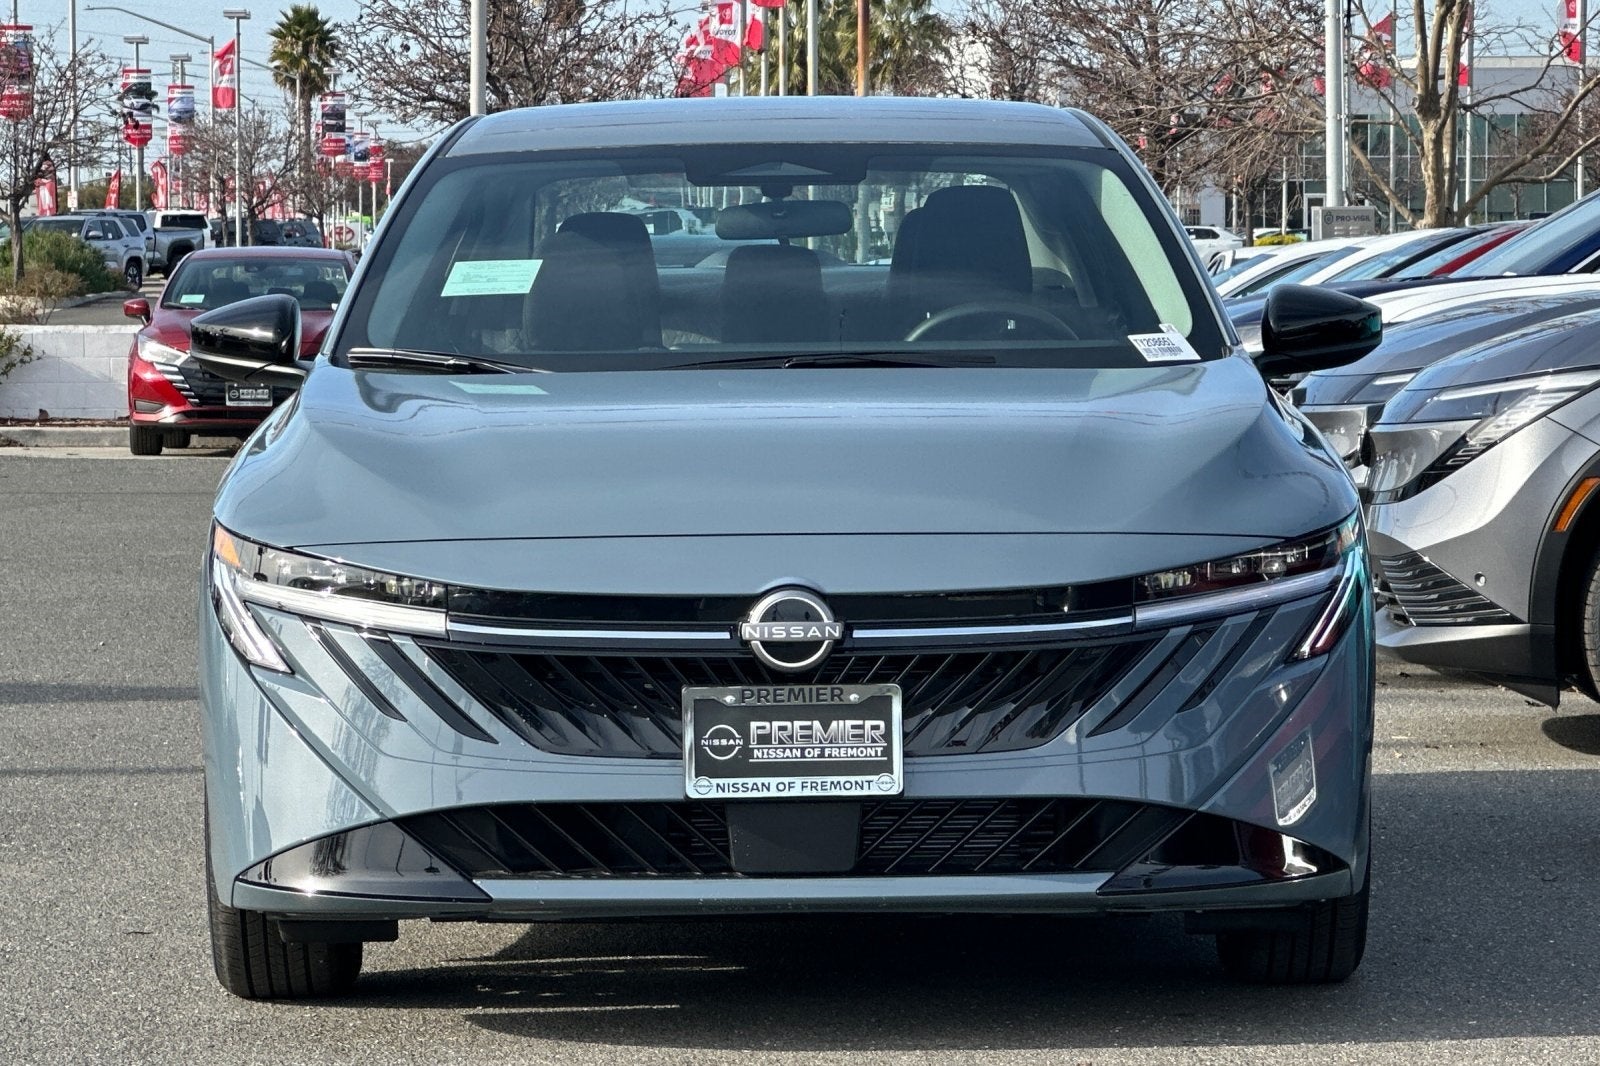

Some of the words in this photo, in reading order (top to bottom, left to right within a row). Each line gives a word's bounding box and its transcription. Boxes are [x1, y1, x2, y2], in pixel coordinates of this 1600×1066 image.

[745, 625, 840, 638] NISSAN
[741, 687, 844, 704] PREMIER
[749, 719, 886, 745] PREMIER
[701, 738, 743, 746] NISSAN
[753, 748, 803, 758] NISSAN
[805, 748, 821, 758] OF
[824, 747, 884, 758] FREMONT
[715, 782, 770, 794] NISSAN
[776, 781, 796, 792] OF
[801, 780, 874, 792] FREMONT
